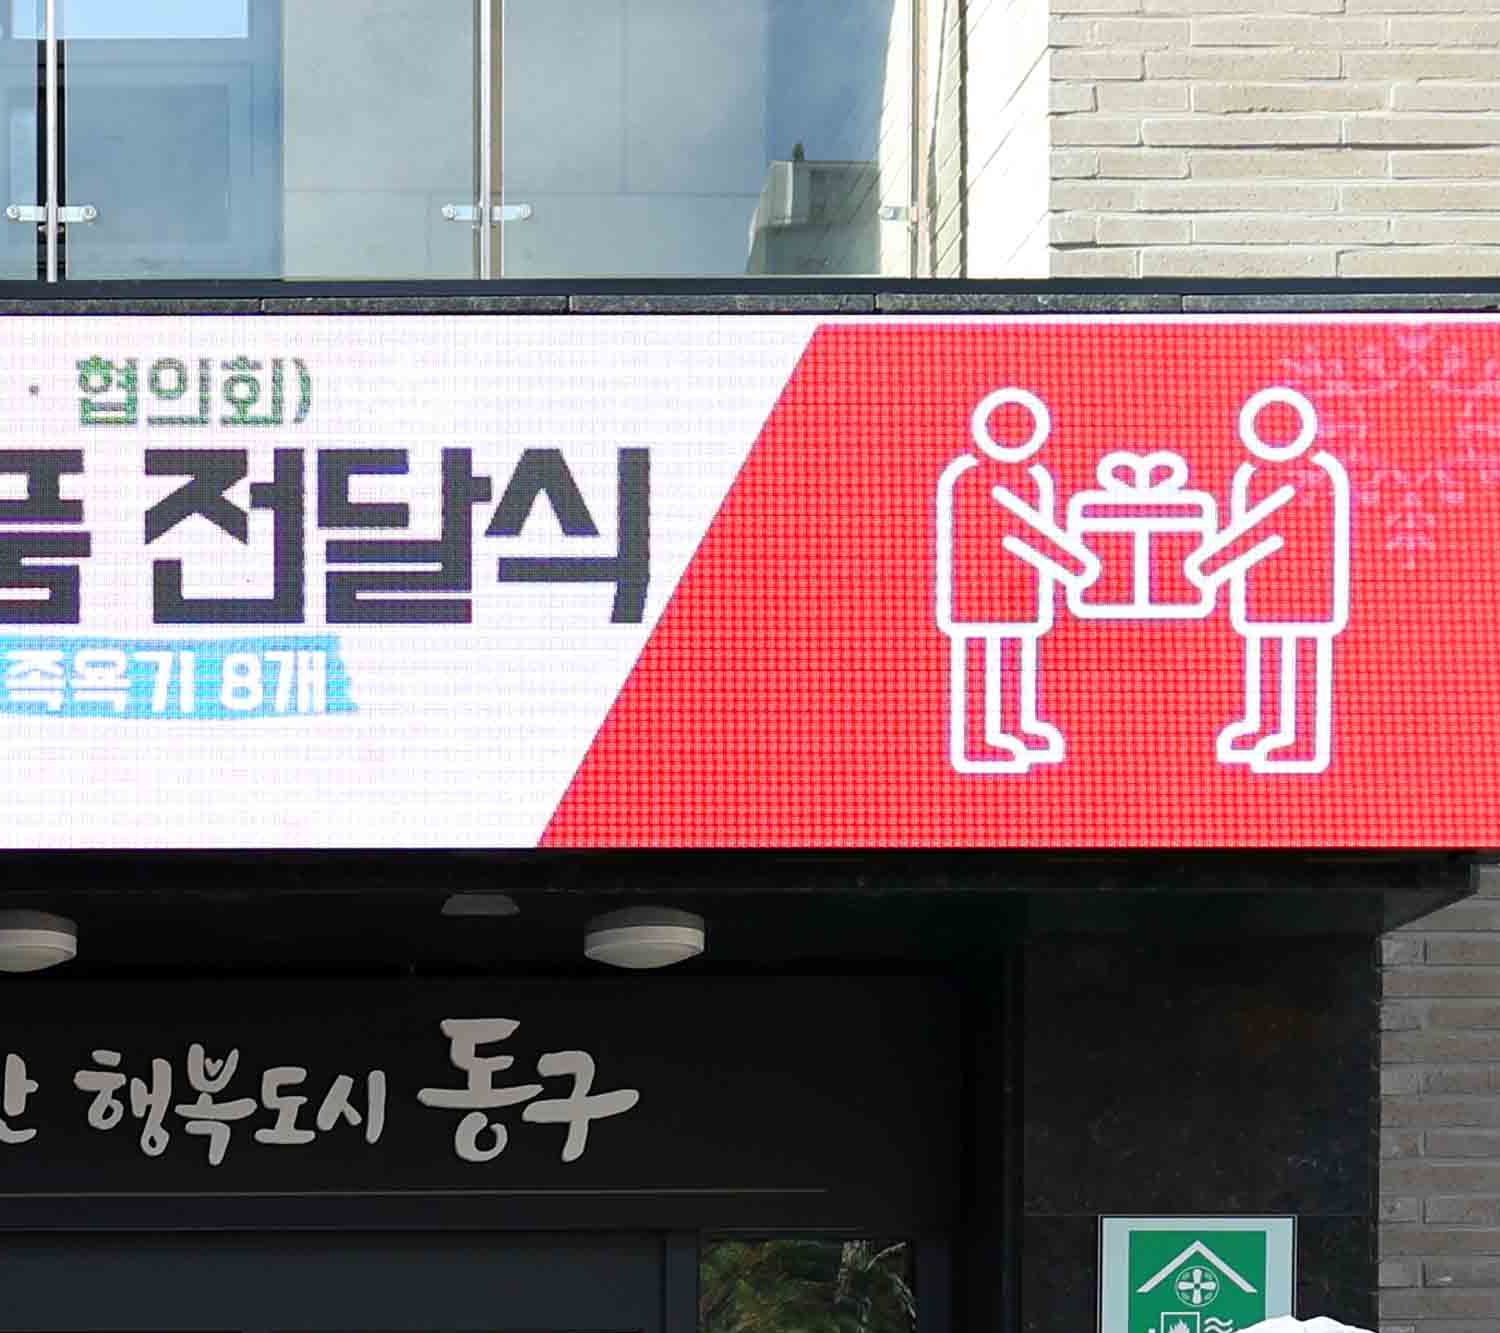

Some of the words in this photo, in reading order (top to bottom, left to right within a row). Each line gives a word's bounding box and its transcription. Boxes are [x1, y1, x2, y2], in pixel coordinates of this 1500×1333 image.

[78, 355, 317, 431] 협의회)
[141, 446, 652, 625] 전달식
[227, 648, 327, 716] 8개
[72, 1043, 389, 1167] 행복도시
[417, 1016, 641, 1164] 동구
